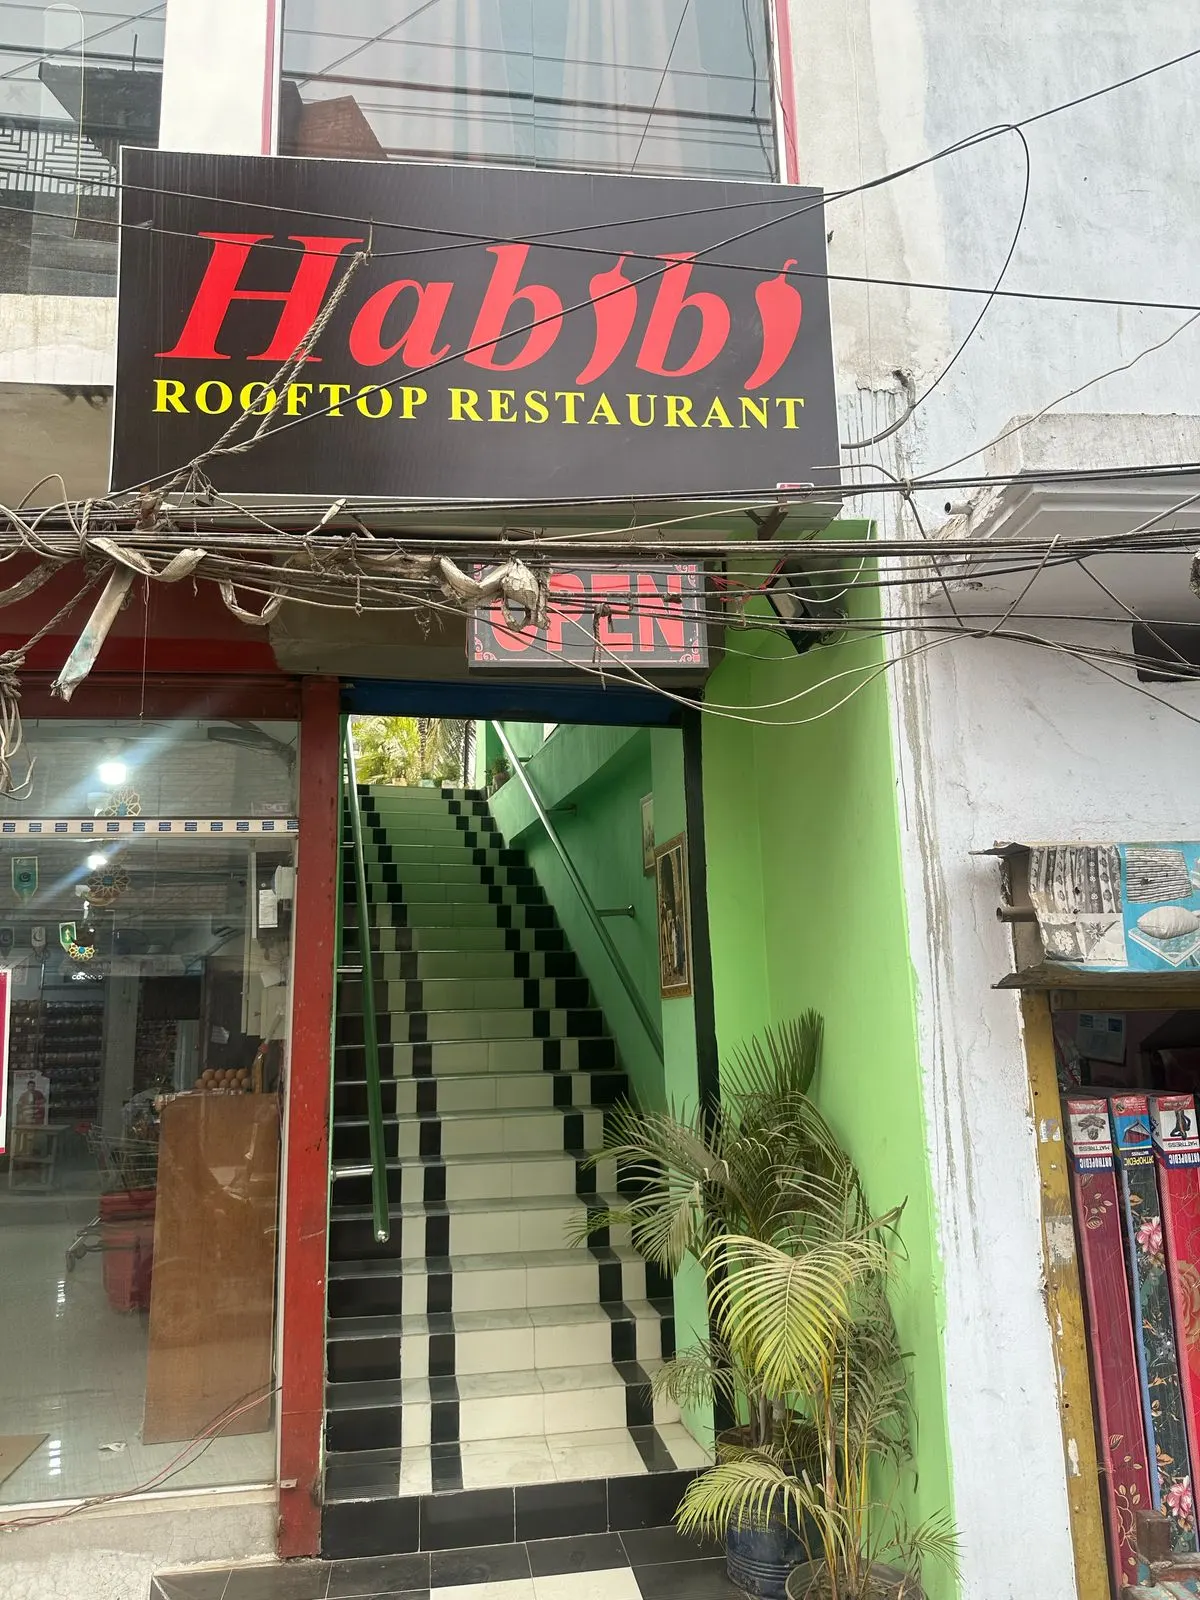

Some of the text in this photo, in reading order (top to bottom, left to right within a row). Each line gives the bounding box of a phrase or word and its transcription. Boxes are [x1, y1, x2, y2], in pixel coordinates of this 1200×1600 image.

[154, 231, 803, 391] Habibi
[151, 378, 805, 430] ROOFTOP RESTAURANT
